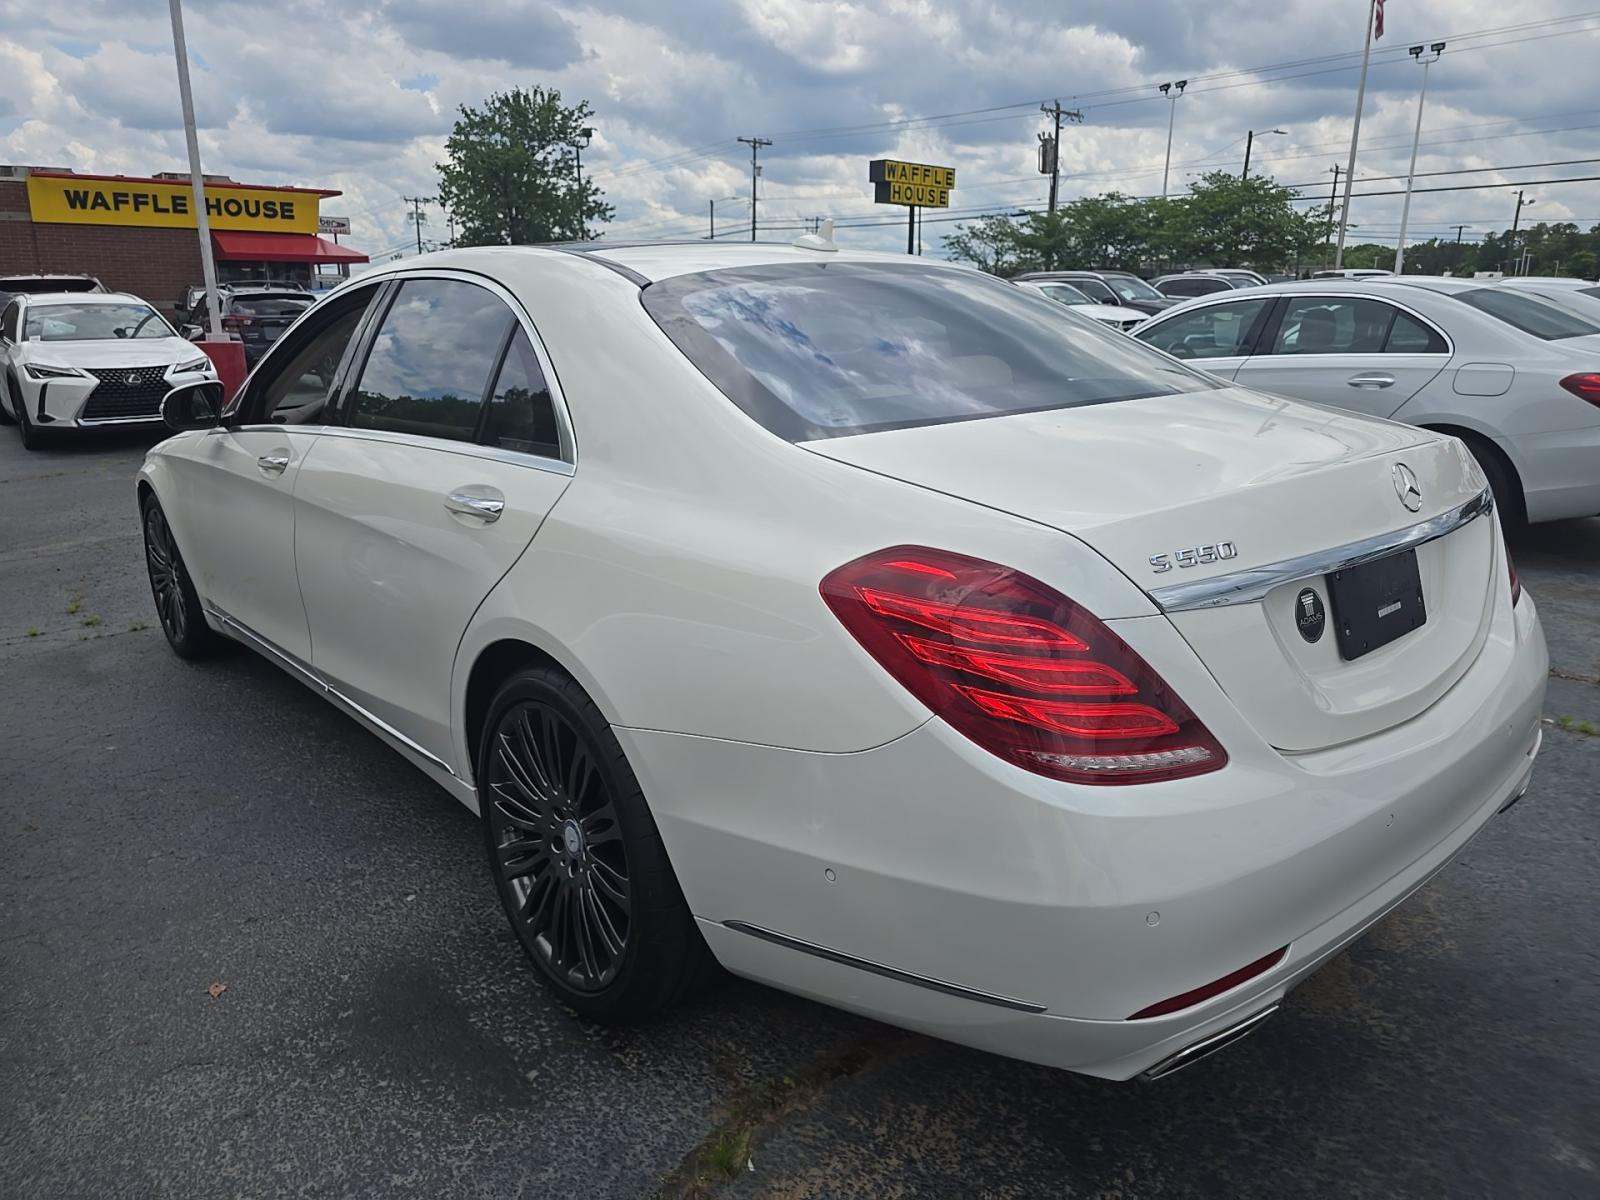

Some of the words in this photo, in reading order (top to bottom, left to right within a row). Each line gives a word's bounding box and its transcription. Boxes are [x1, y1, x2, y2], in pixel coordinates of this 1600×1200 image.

[886, 163, 954, 187] WAFFLE
[63, 189, 188, 215] WAFFLE
[205, 196, 295, 220] HOUSE
[892, 183, 947, 205] HOUSE
[1148, 553, 1173, 574] S
[1175, 541, 1238, 568] 550
